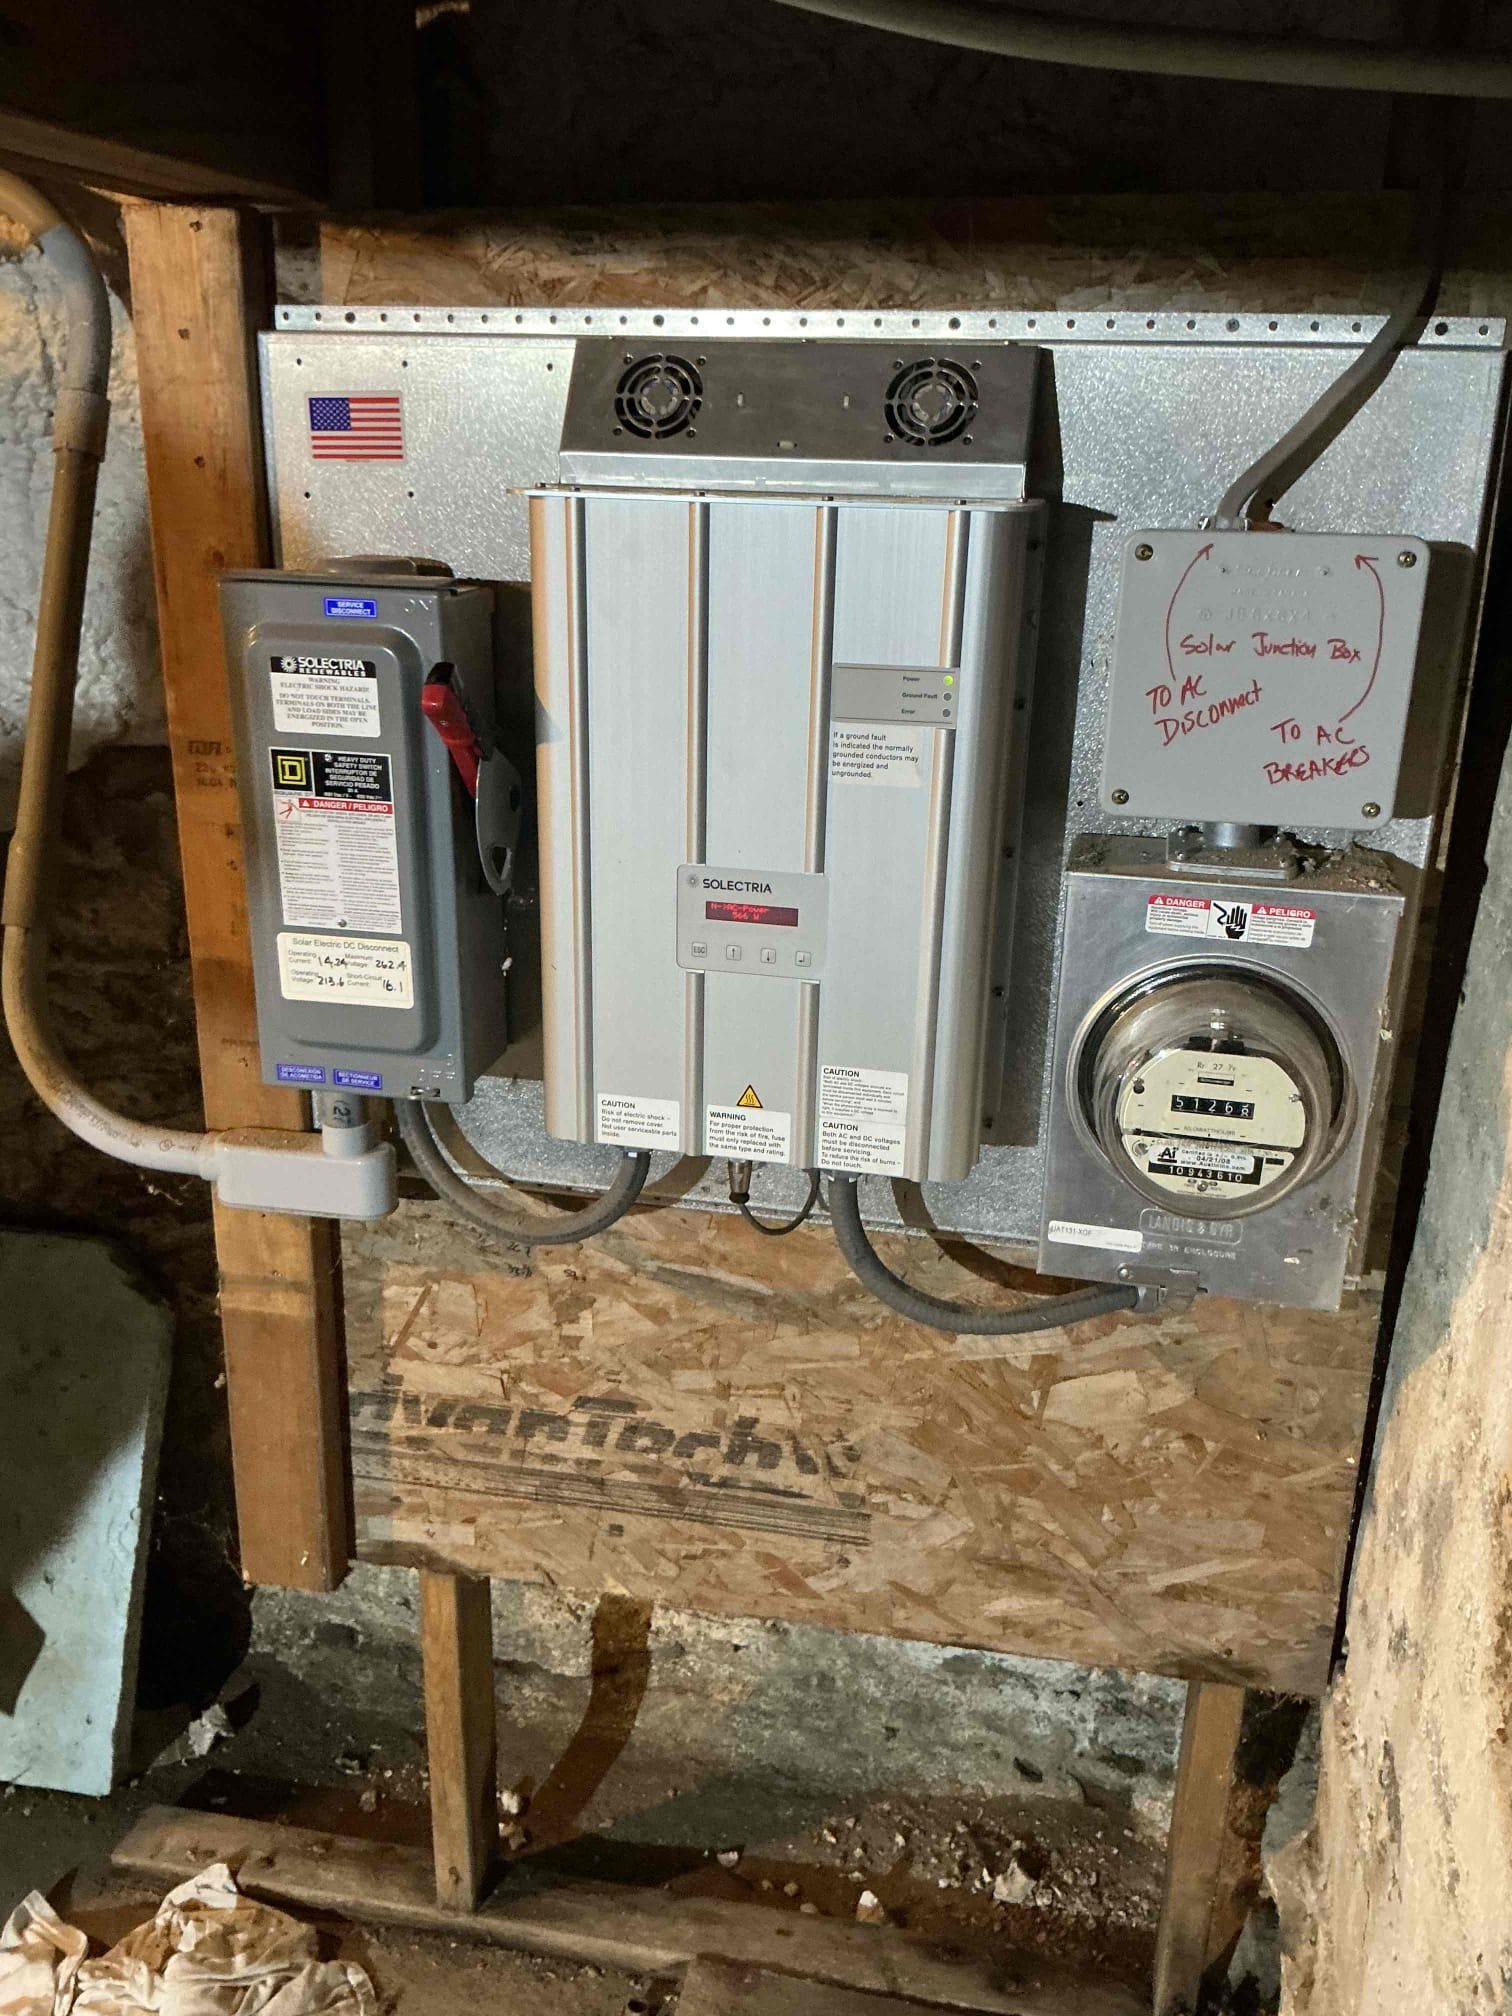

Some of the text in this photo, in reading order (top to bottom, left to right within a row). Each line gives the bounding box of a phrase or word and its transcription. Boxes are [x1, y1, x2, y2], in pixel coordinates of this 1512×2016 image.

[1180, 632, 1361, 663] Solar Junction Box
[298, 657, 365, 670] SOLECTRIA
[299, 668, 366, 676] RENEWABLES
[1180, 675, 1207, 705] AC
[1317, 726, 1355, 745] AC
[885, 745, 913, 753] normally
[832, 752, 864, 760] grounded
[866, 753, 903, 761] conductors
[842, 761, 874, 769] energized
[313, 800, 347, 810] DANGER
[353, 803, 388, 812] PELIGRO
[703, 879, 772, 893] SOLECTRIA
[1166, 898, 1205, 908] DANGER
[1269, 908, 1311, 918] PELIGRO
[292, 938, 399, 953] Solar Electric DC Disconnect
[823, 1068, 860, 1077] CAUTION
[601, 1099, 636, 1109] CAUTION
[624, 1111, 645, 1119] electric
[647, 1113, 665, 1121] shock
[709, 1111, 746, 1121] WARNING
[627, 1126, 660, 1135] serviceable
[662, 1129, 677, 1137] parts
[743, 1125, 774, 1133] protection
[823, 1122, 858, 1131] CAUTION
[726, 1137, 738, 1145] only
[740, 1138, 766, 1147] replaced
[771, 1134, 785, 1142] fuse
[874, 1137, 901, 1145] voltages
[739, 1145, 751, 1153] type
[849, 1141, 890, 1151] disconnected
[1149, 1215, 1193, 1233] LANDIS
[1184, 1246, 1236, 1260] ENCLOSURE
